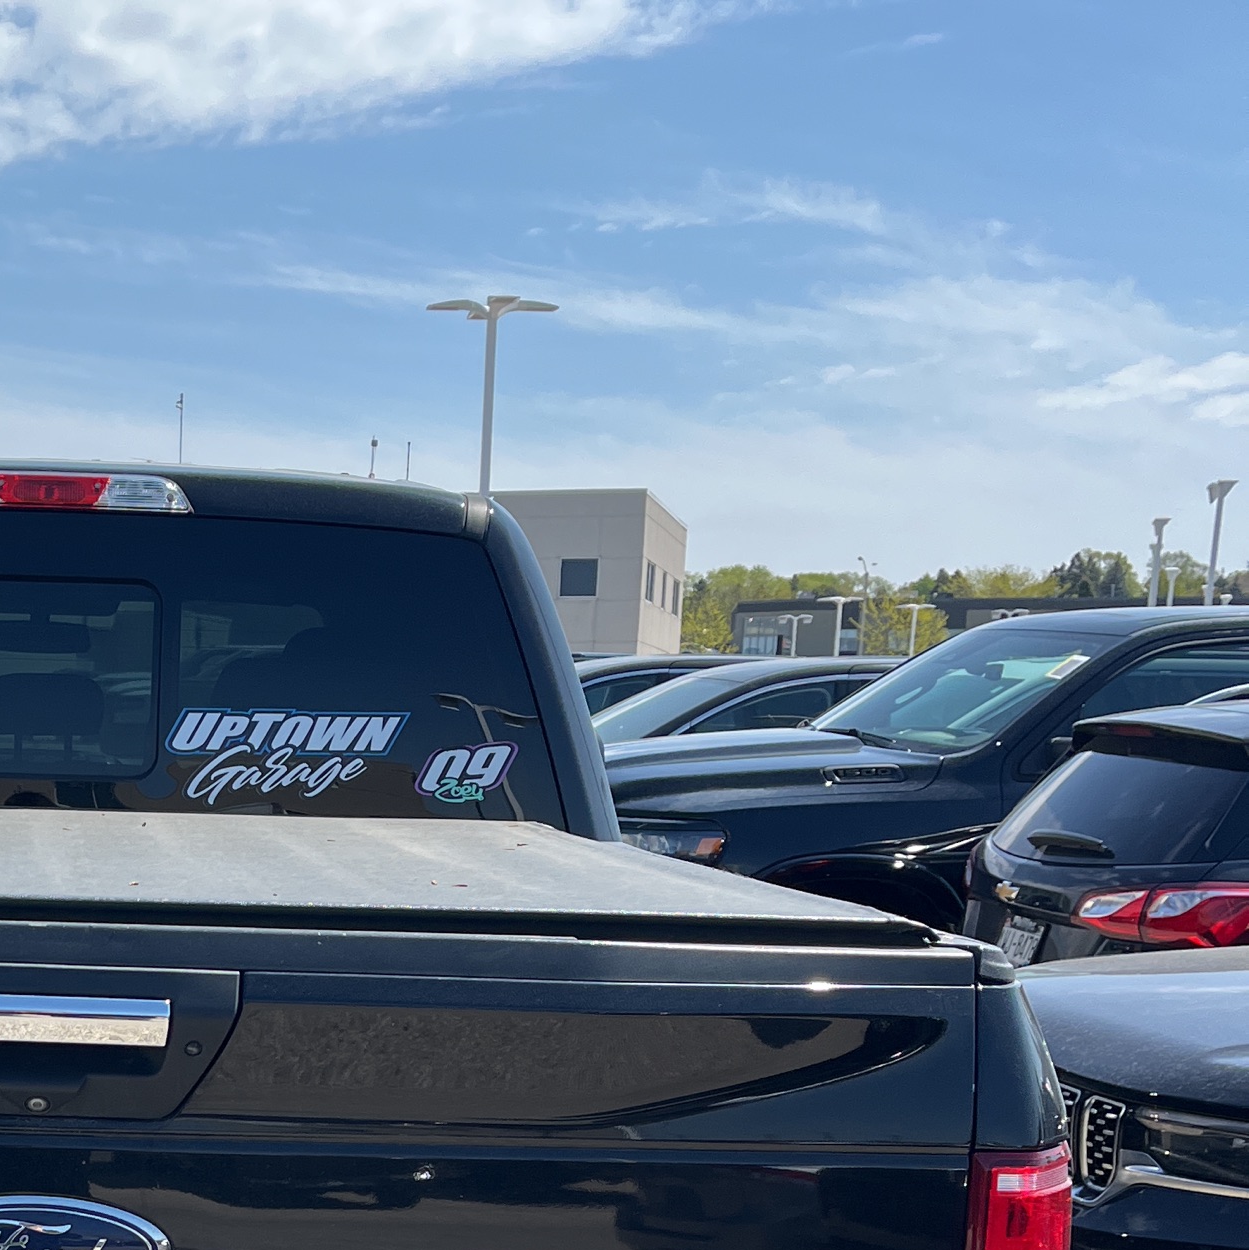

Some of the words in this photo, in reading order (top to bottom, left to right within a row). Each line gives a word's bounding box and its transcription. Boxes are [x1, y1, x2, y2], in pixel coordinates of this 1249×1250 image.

[172, 711, 402, 752] UPTOWN
[185, 745, 368, 805] Garage
[421, 745, 512, 791] 09
[434, 778, 485, 803] Zoey
